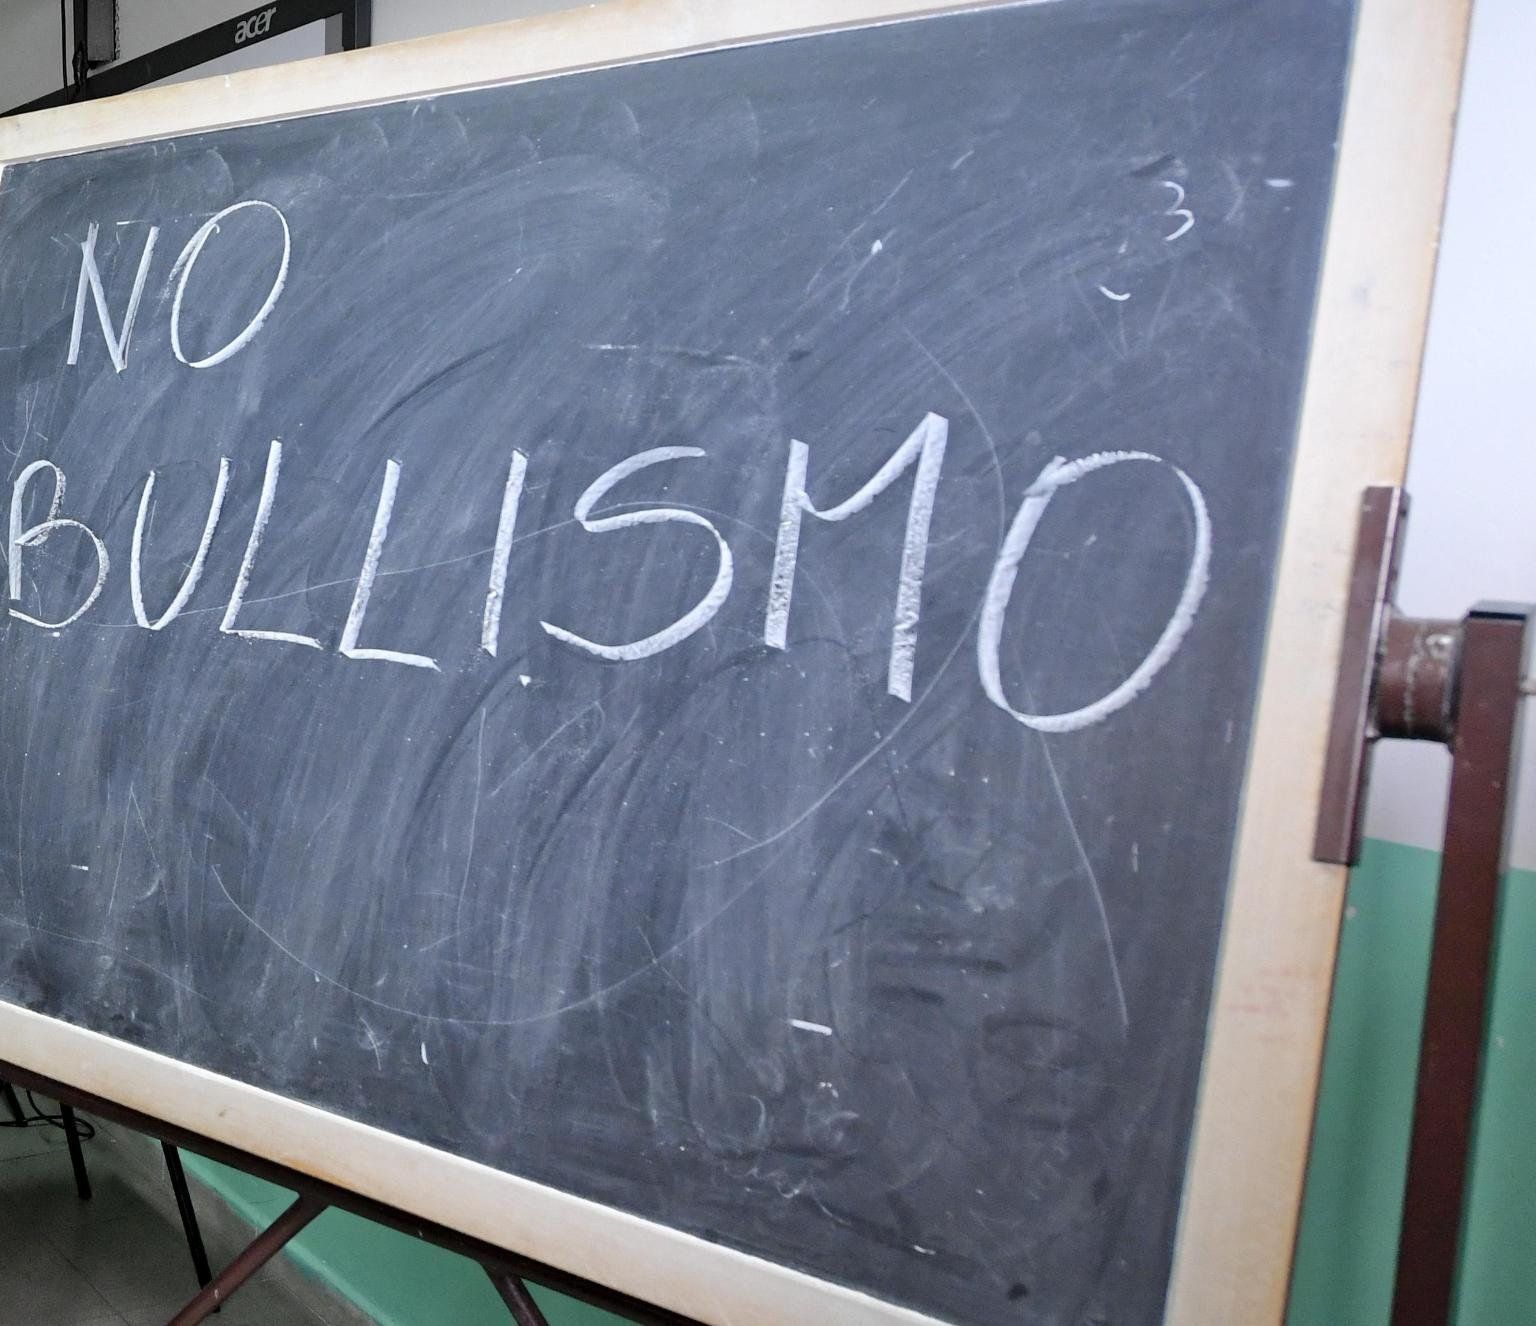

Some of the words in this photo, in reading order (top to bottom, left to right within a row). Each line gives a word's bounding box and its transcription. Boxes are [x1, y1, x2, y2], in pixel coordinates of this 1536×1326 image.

[234, 7, 277, 43] acer
[67, 199, 291, 373] NO
[8, 411, 1212, 733] BULLISMO
